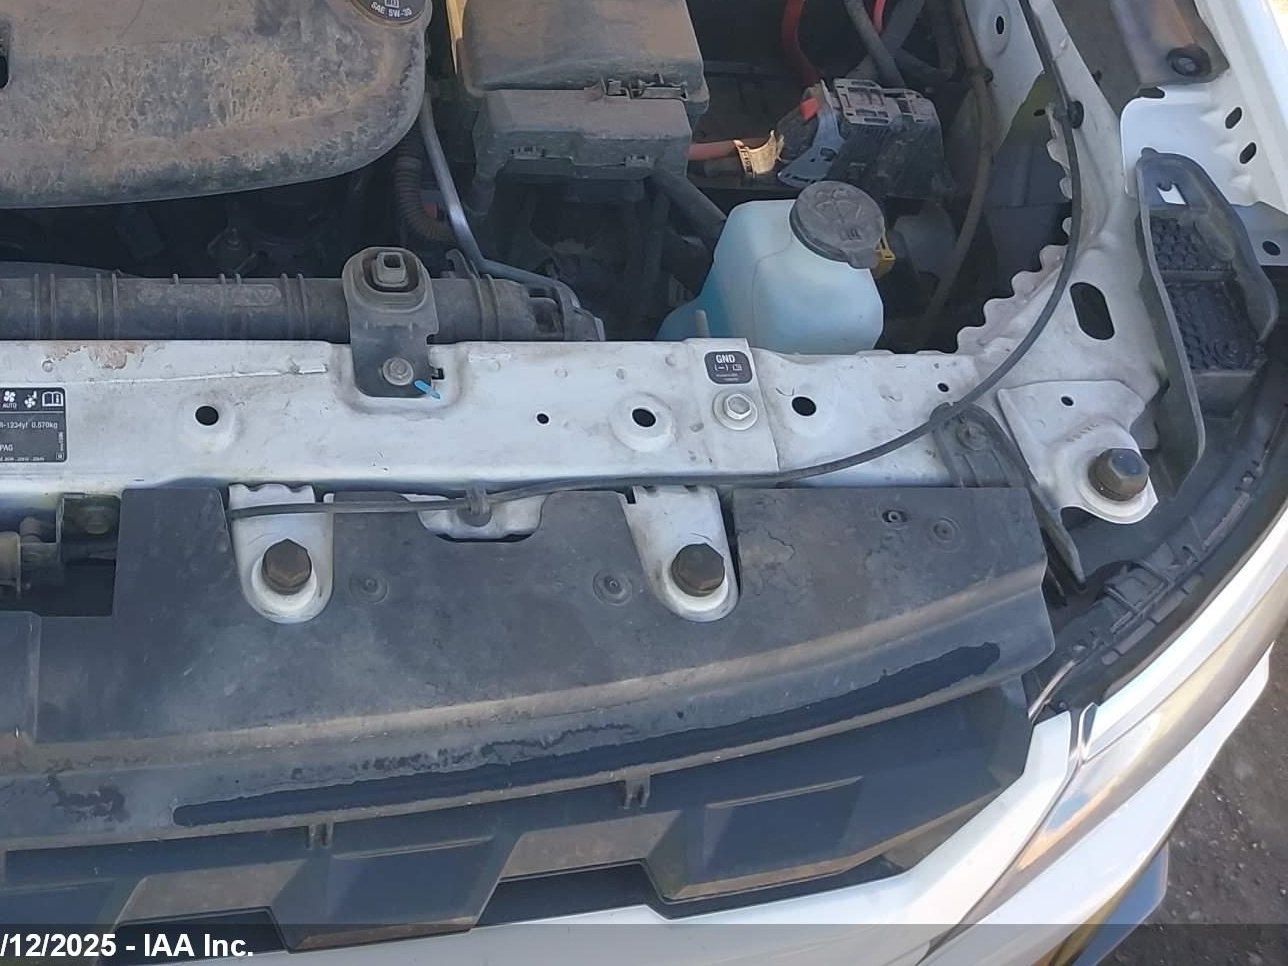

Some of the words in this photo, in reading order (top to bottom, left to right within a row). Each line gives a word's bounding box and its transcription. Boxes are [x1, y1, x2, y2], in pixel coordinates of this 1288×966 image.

[371, 1, 385, 15] SAE
[388, 7, 413, 18] 5W-30
[715, 354, 736, 363] GND
[0, 443, 14, 452] PAG
